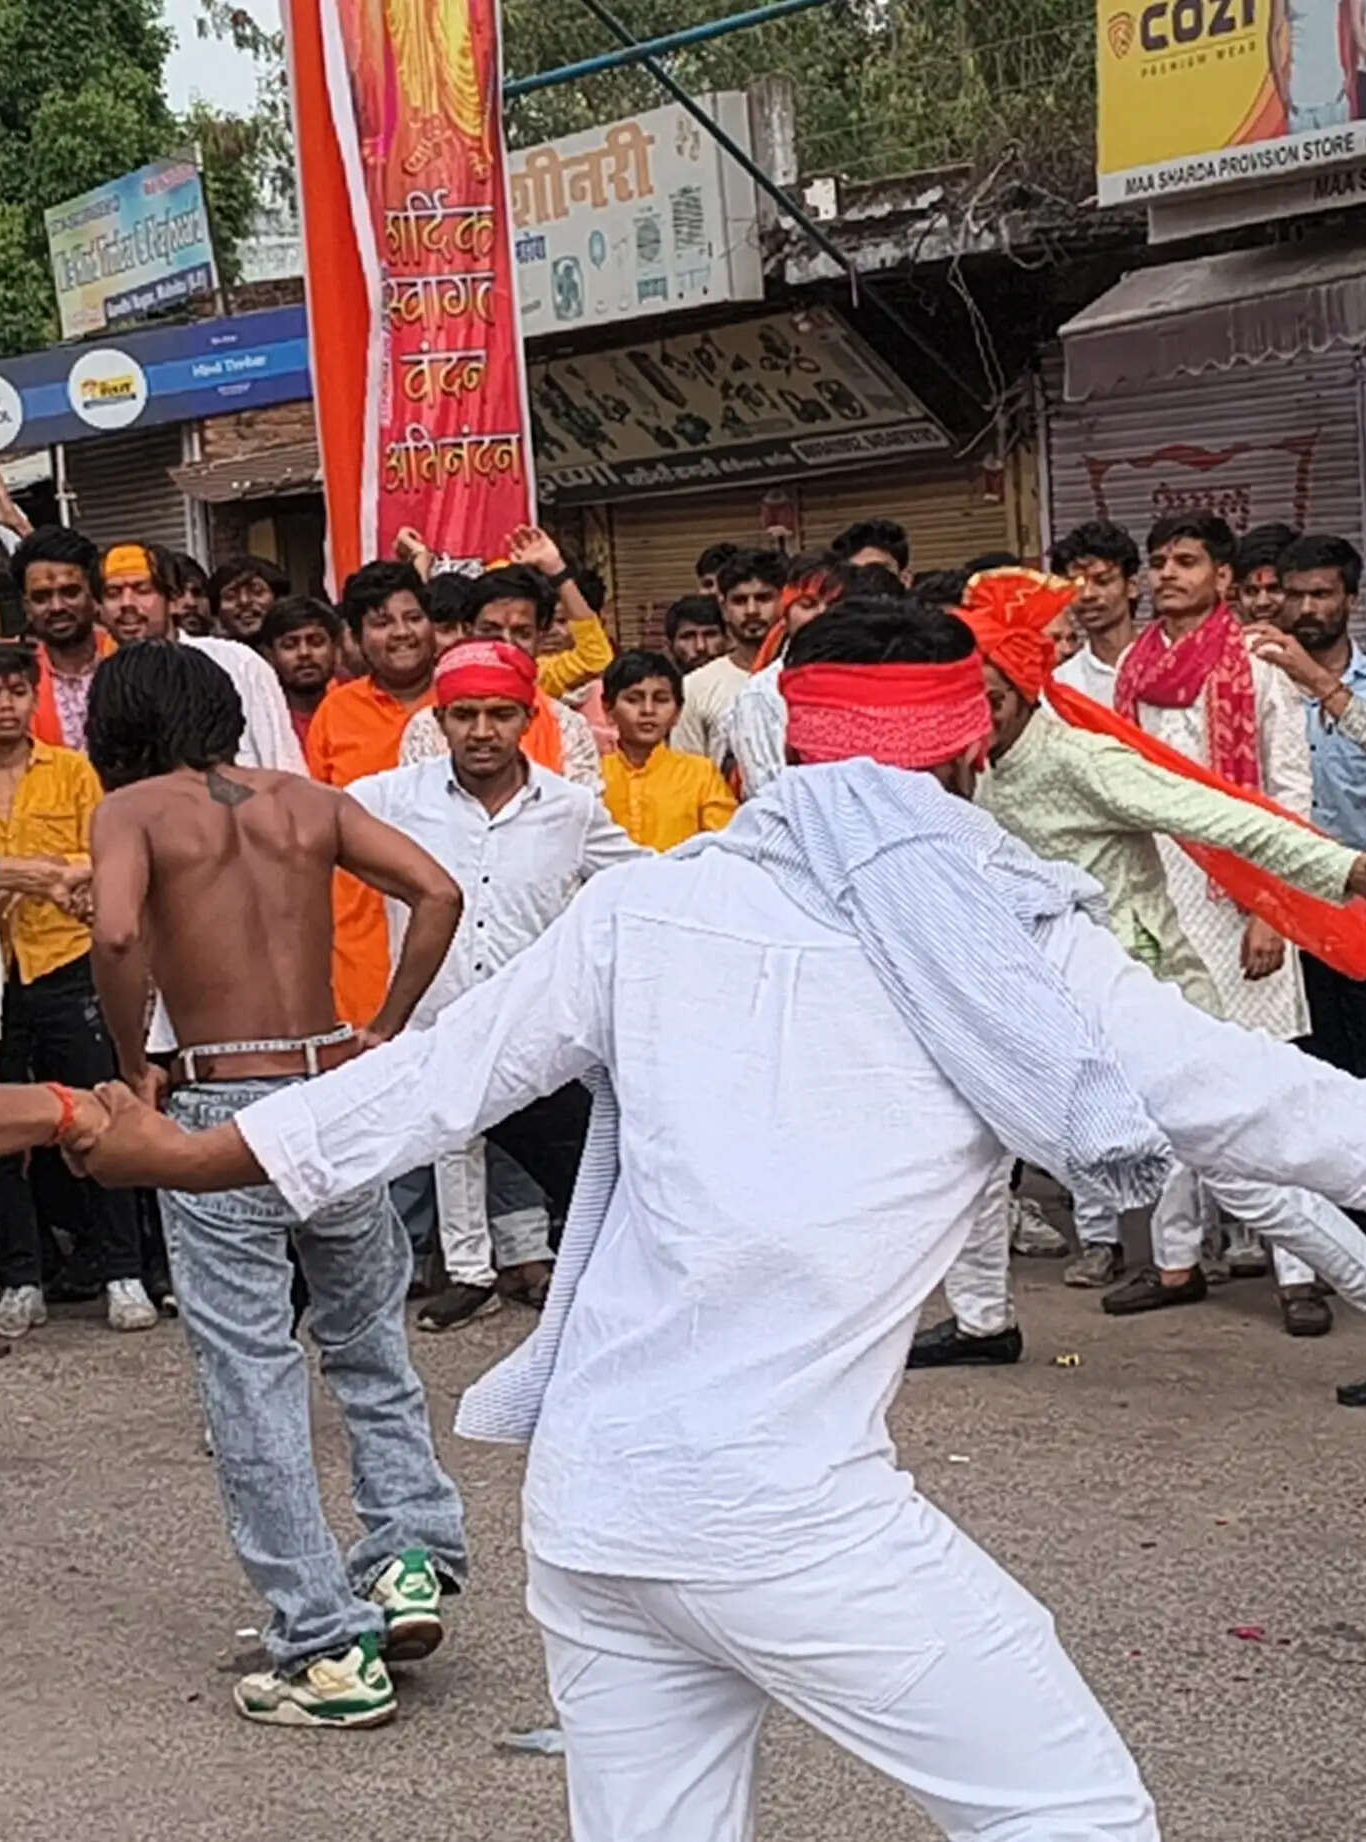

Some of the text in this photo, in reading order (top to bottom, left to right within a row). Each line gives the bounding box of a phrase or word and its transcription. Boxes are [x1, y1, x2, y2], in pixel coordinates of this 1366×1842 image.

[1140, 40, 1257, 79] PREMIUM WEAR
[1123, 131, 1356, 197] MAA SHARDA PROVISION STORE
[1312, 171, 1357, 201] MAA
[399, 340, 487, 409] वंदन
